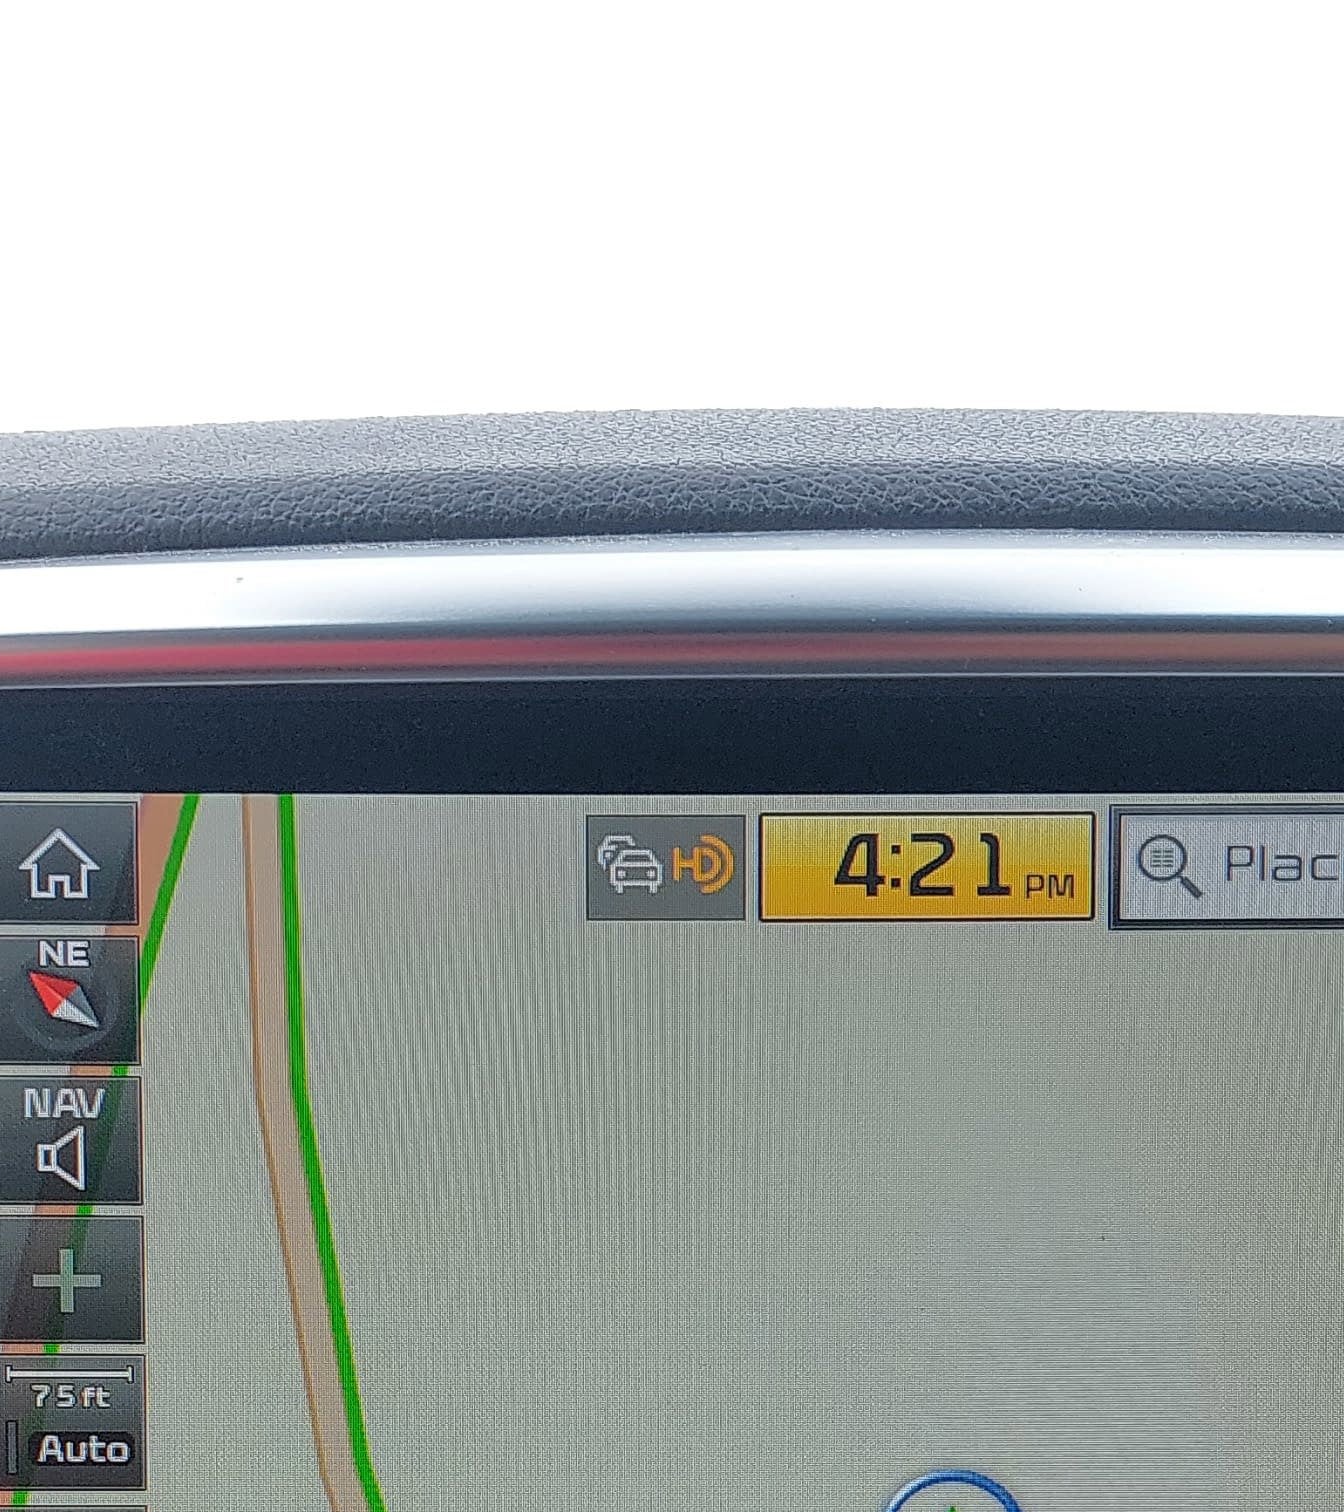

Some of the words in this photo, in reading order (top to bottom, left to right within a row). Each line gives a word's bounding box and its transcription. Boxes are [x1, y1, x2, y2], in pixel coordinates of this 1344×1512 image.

[833, 832, 1011, 898] 4:21
[1024, 873, 1076, 900] PM
[37, 940, 90, 967] NE
[23, 1087, 106, 1119] NAV
[36, 1436, 131, 1465] Auto
